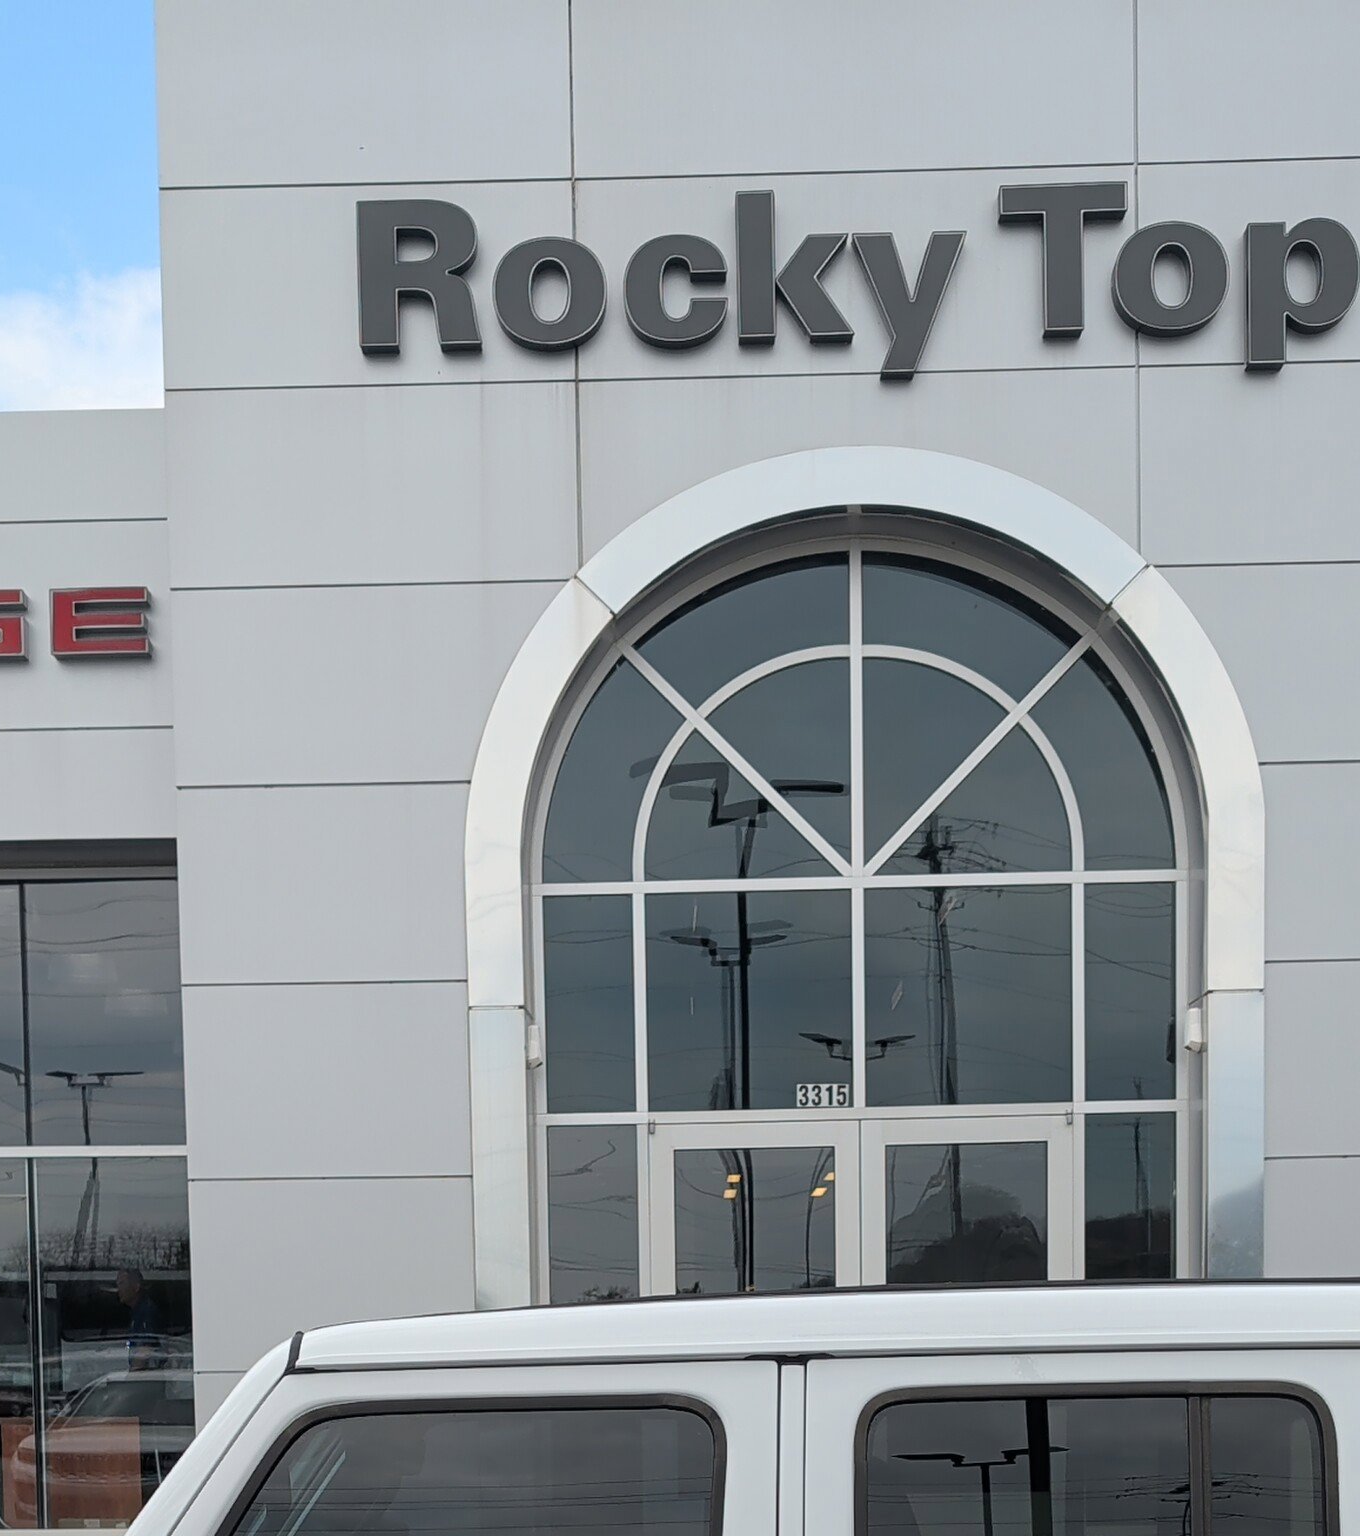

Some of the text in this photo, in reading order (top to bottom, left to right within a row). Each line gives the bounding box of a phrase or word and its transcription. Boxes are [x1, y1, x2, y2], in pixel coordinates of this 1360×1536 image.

[356, 181, 1360, 381] Rocky Top
[798, 1084, 848, 1106] 3315
